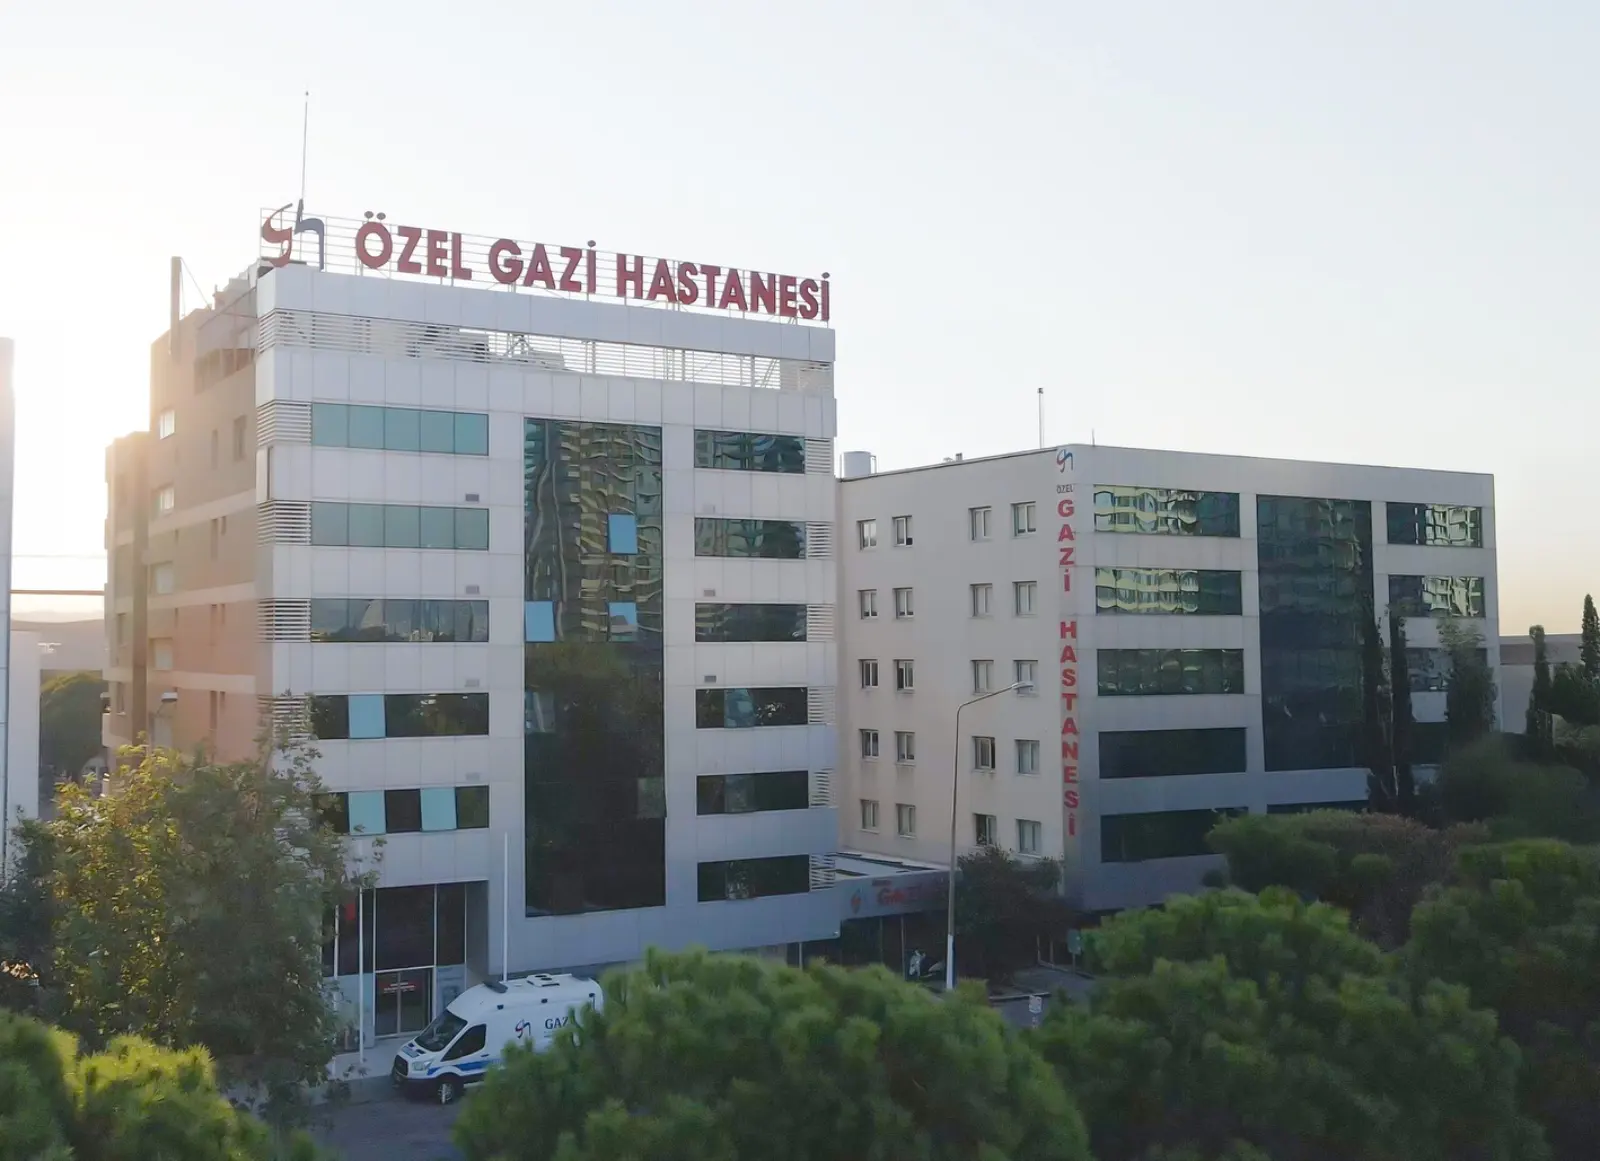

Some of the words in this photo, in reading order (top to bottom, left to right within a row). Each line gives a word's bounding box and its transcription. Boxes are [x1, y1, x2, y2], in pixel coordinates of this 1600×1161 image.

[355, 211, 472, 281] ÖZEL
[488, 239, 598, 295] GAZİ
[616, 252, 831, 322] HASTANESİ
[1057, 498, 1075, 593] GAZİ
[1059, 620, 1080, 837] HASTANESİ
[544, 1016, 569, 1030] GAZ
